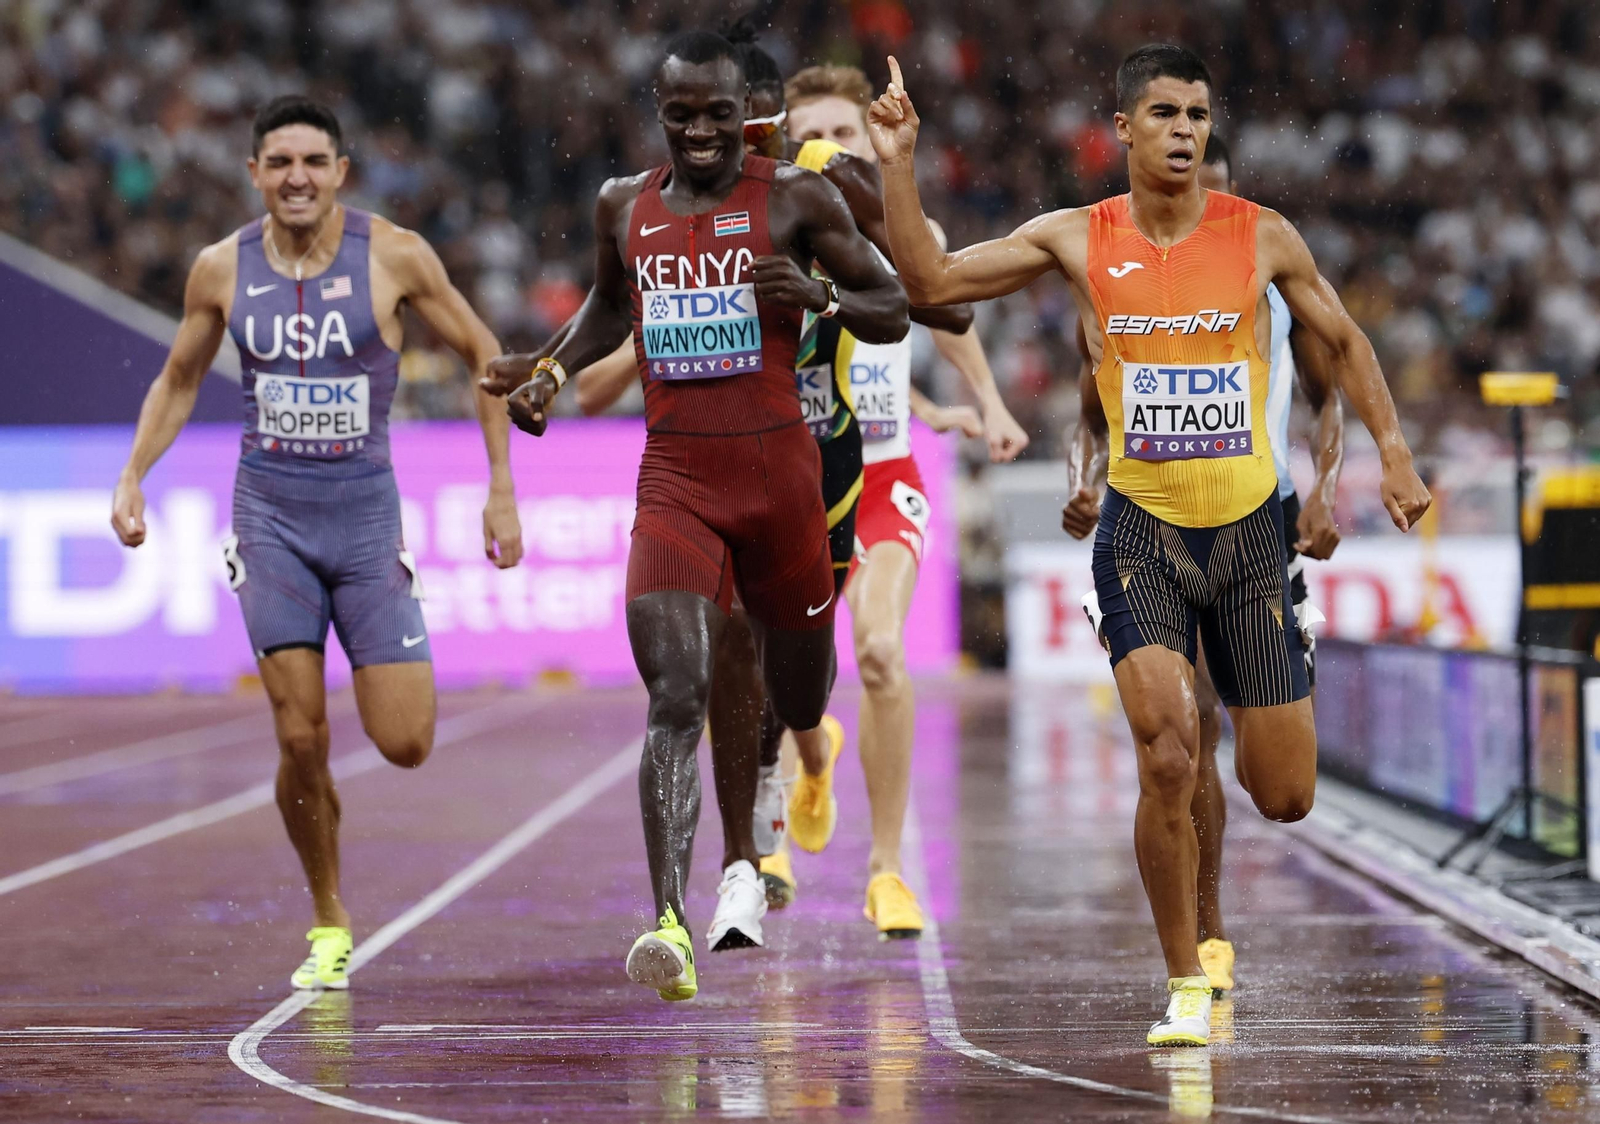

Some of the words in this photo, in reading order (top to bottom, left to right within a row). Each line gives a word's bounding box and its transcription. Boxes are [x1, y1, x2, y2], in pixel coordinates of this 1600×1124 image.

[636, 247, 754, 291] KENYA
[669, 289, 748, 319] TDK
[245, 310, 354, 361] USA
[1106, 309, 1242, 336] ESPAÑA
[647, 321, 756, 355] WANYONYI
[850, 364, 892, 385] DK
[1158, 366, 1243, 395] TDK
[284, 382, 358, 405] TDK
[264, 407, 363, 435] HOPPEL
[1130, 400, 1245, 433] ATTAOUI
